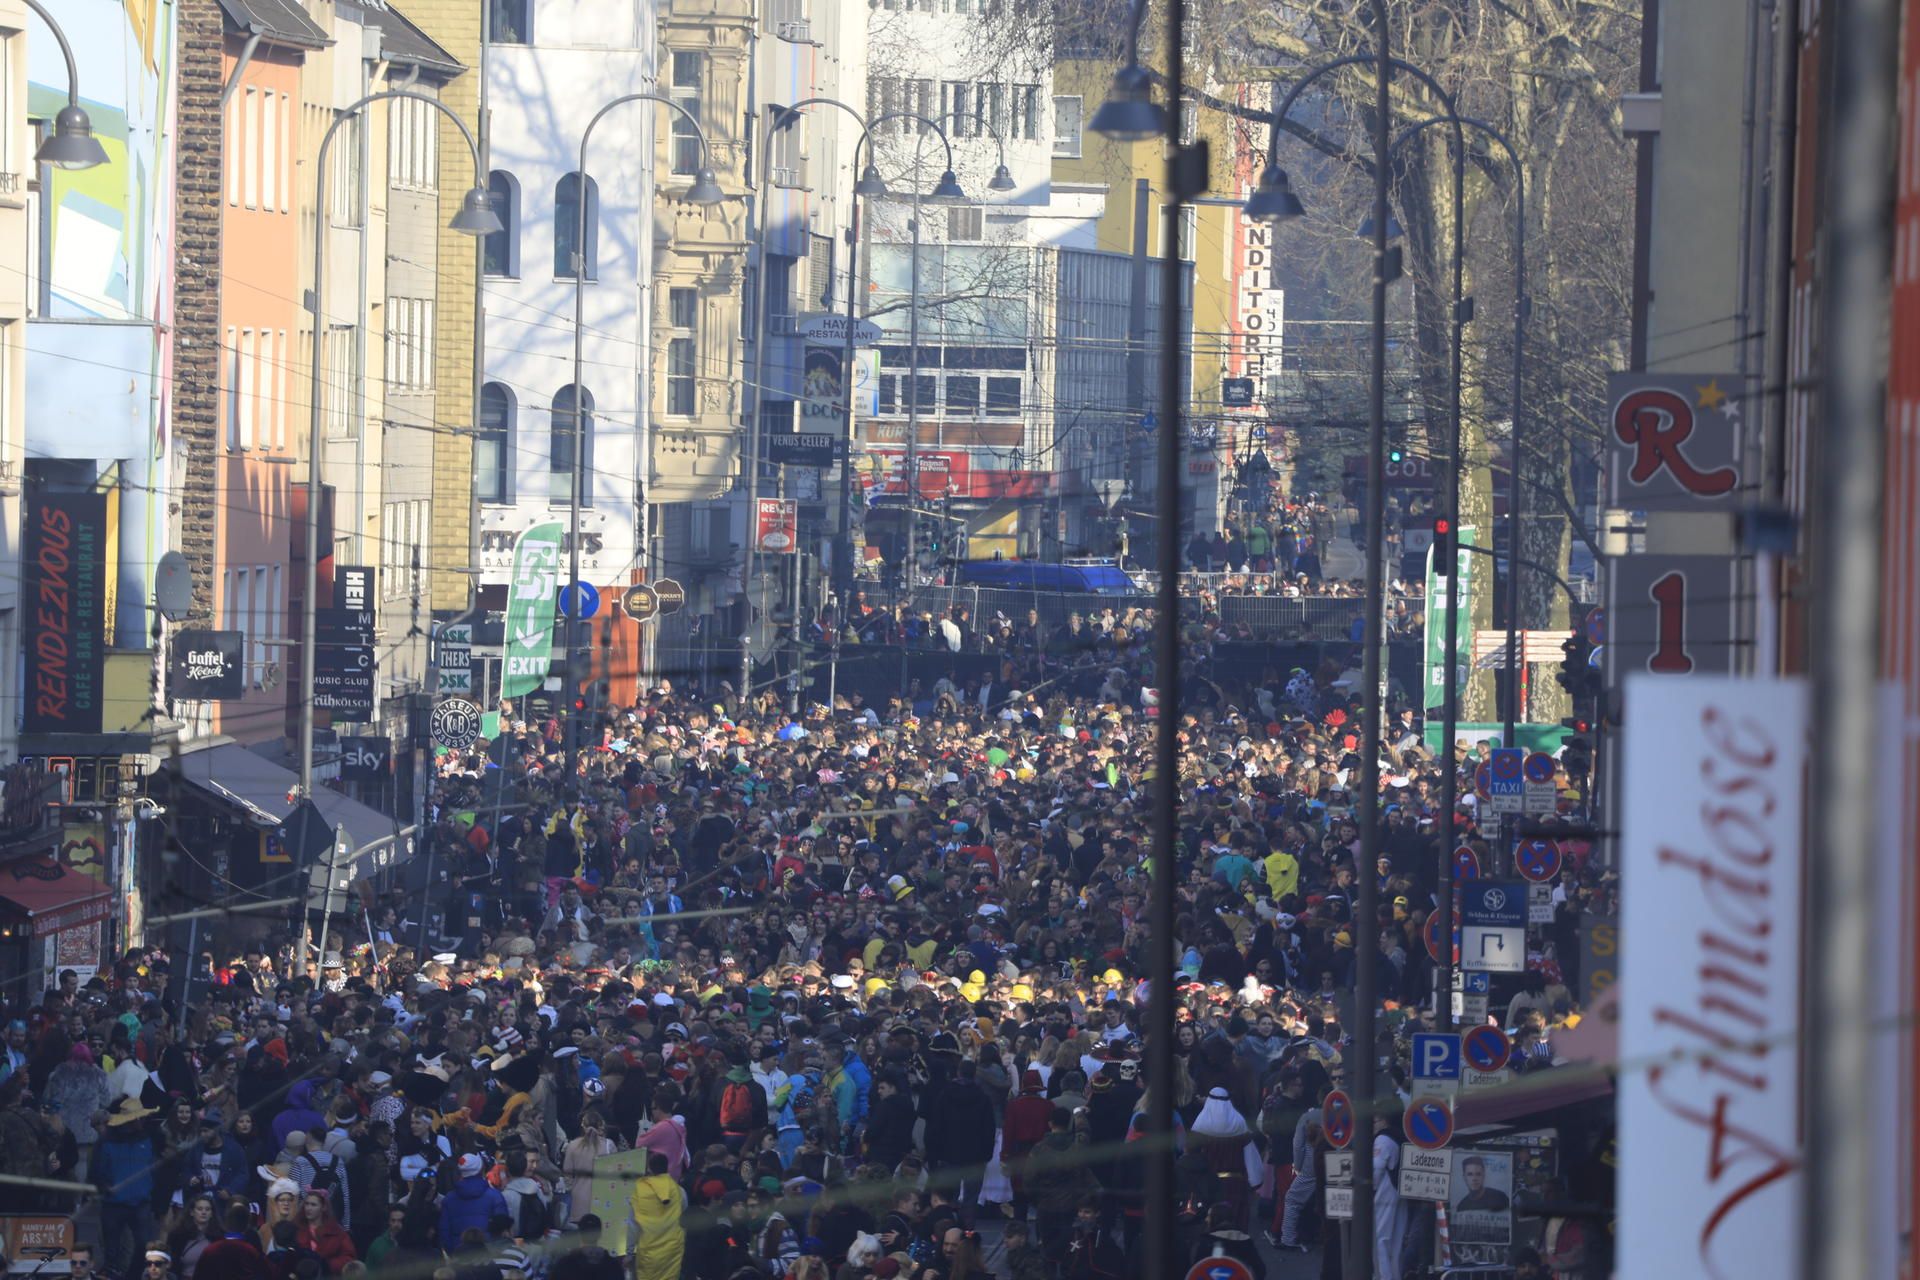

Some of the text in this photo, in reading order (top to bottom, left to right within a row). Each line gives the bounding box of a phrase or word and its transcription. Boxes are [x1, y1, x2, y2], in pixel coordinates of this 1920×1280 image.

[808, 329, 874, 340] RESTAUANT
[772, 435, 830, 448] VENUS CELLER
[1613, 382, 1739, 498] R
[36, 506, 71, 720] RENDEZVOUS
[74, 522, 95, 710] CAFÉ BAR RESTAURANT
[187, 650, 225, 666] Gaffel
[507, 656, 547, 676] EXIT
[186, 665, 225, 680] Kölsch
[345, 677, 369, 687] CLUB
[446, 713, 466, 735] K&B
[345, 747, 384, 770] sky
[1493, 782, 1520, 793] TAXI
[1423, 1040, 1449, 1076] P
[1411, 1152, 1445, 1168] Ladezone
